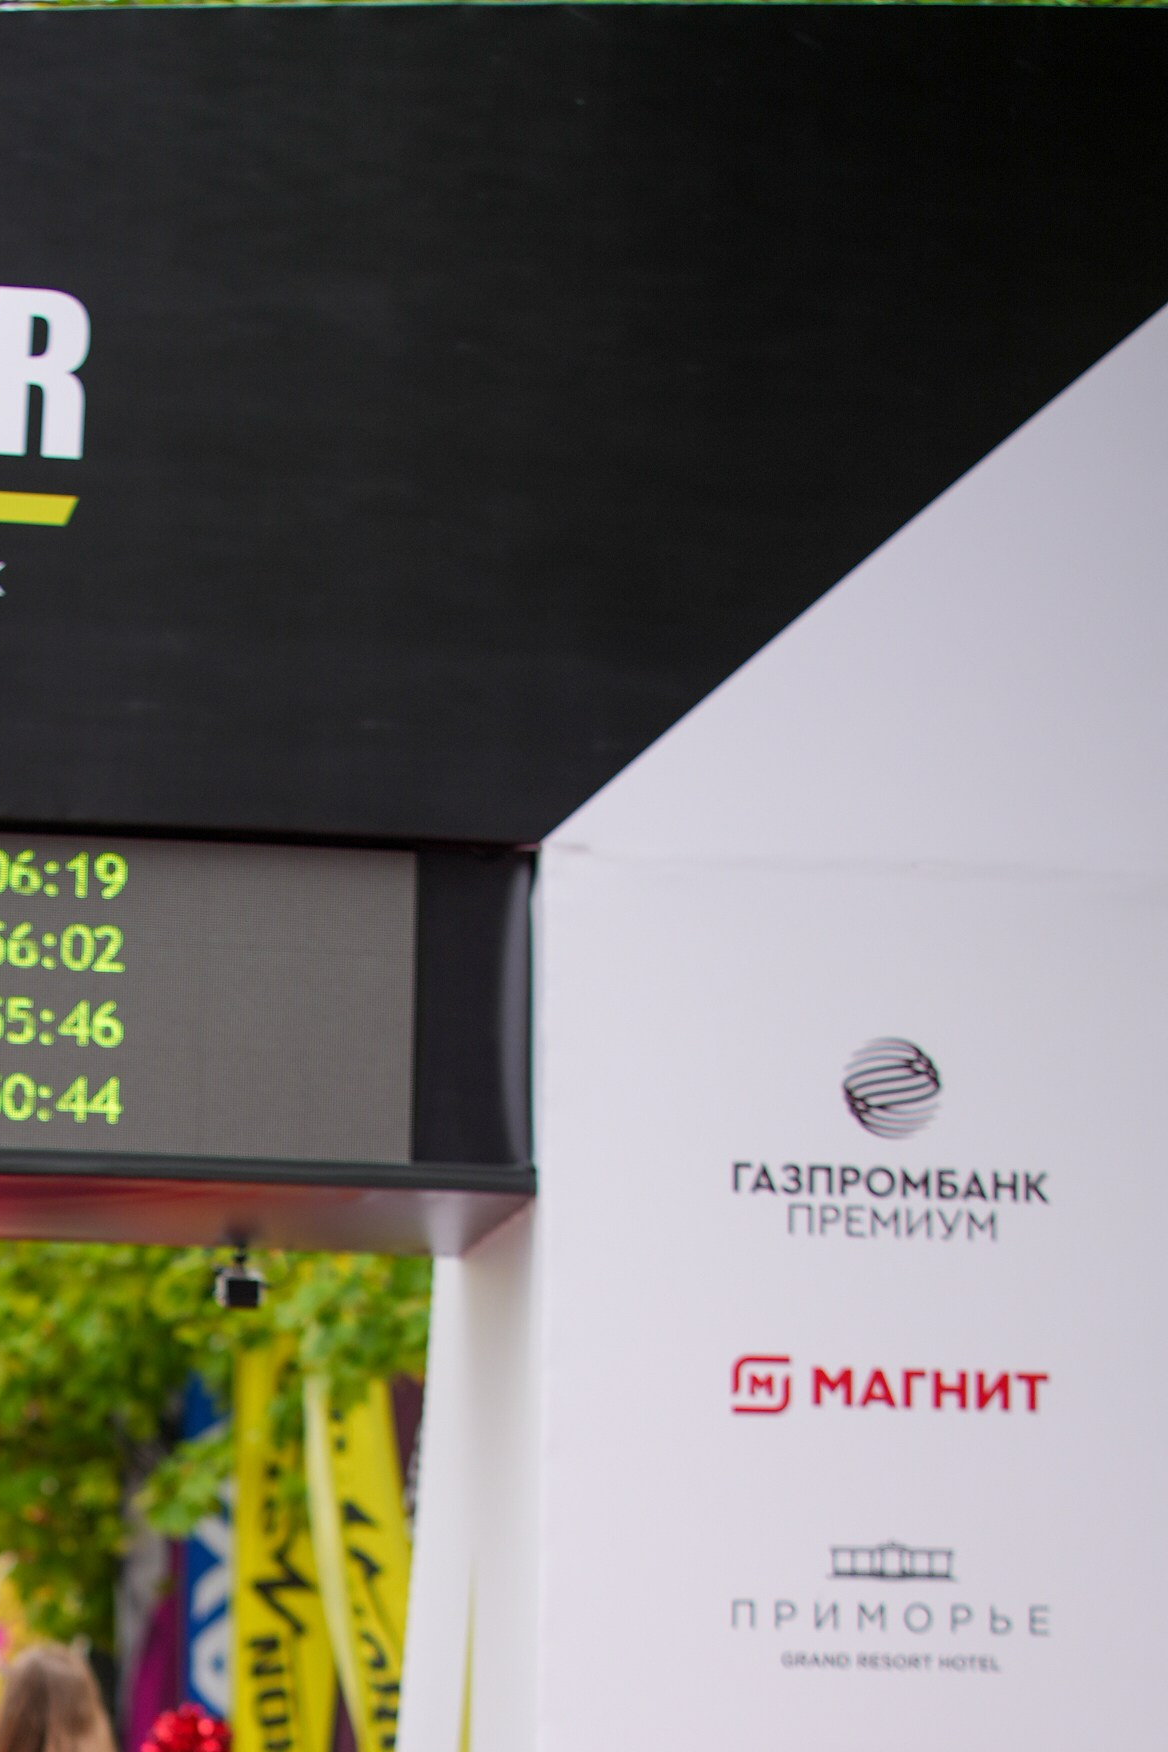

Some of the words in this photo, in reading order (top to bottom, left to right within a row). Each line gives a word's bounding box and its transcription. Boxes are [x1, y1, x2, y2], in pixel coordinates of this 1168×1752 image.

[732, 1161, 1050, 1206] ГАЗПРОМБАНК
[787, 1201, 999, 1241] ПРЕМИУМ
[812, 1367, 1050, 1413] МАГНИТ
[731, 1598, 1051, 1639] ПРИМОРЬЕ
[780, 1651, 852, 1670] GRAND
[855, 1652, 933, 1672] RESORT
[938, 1654, 1001, 1673] HOTEL
